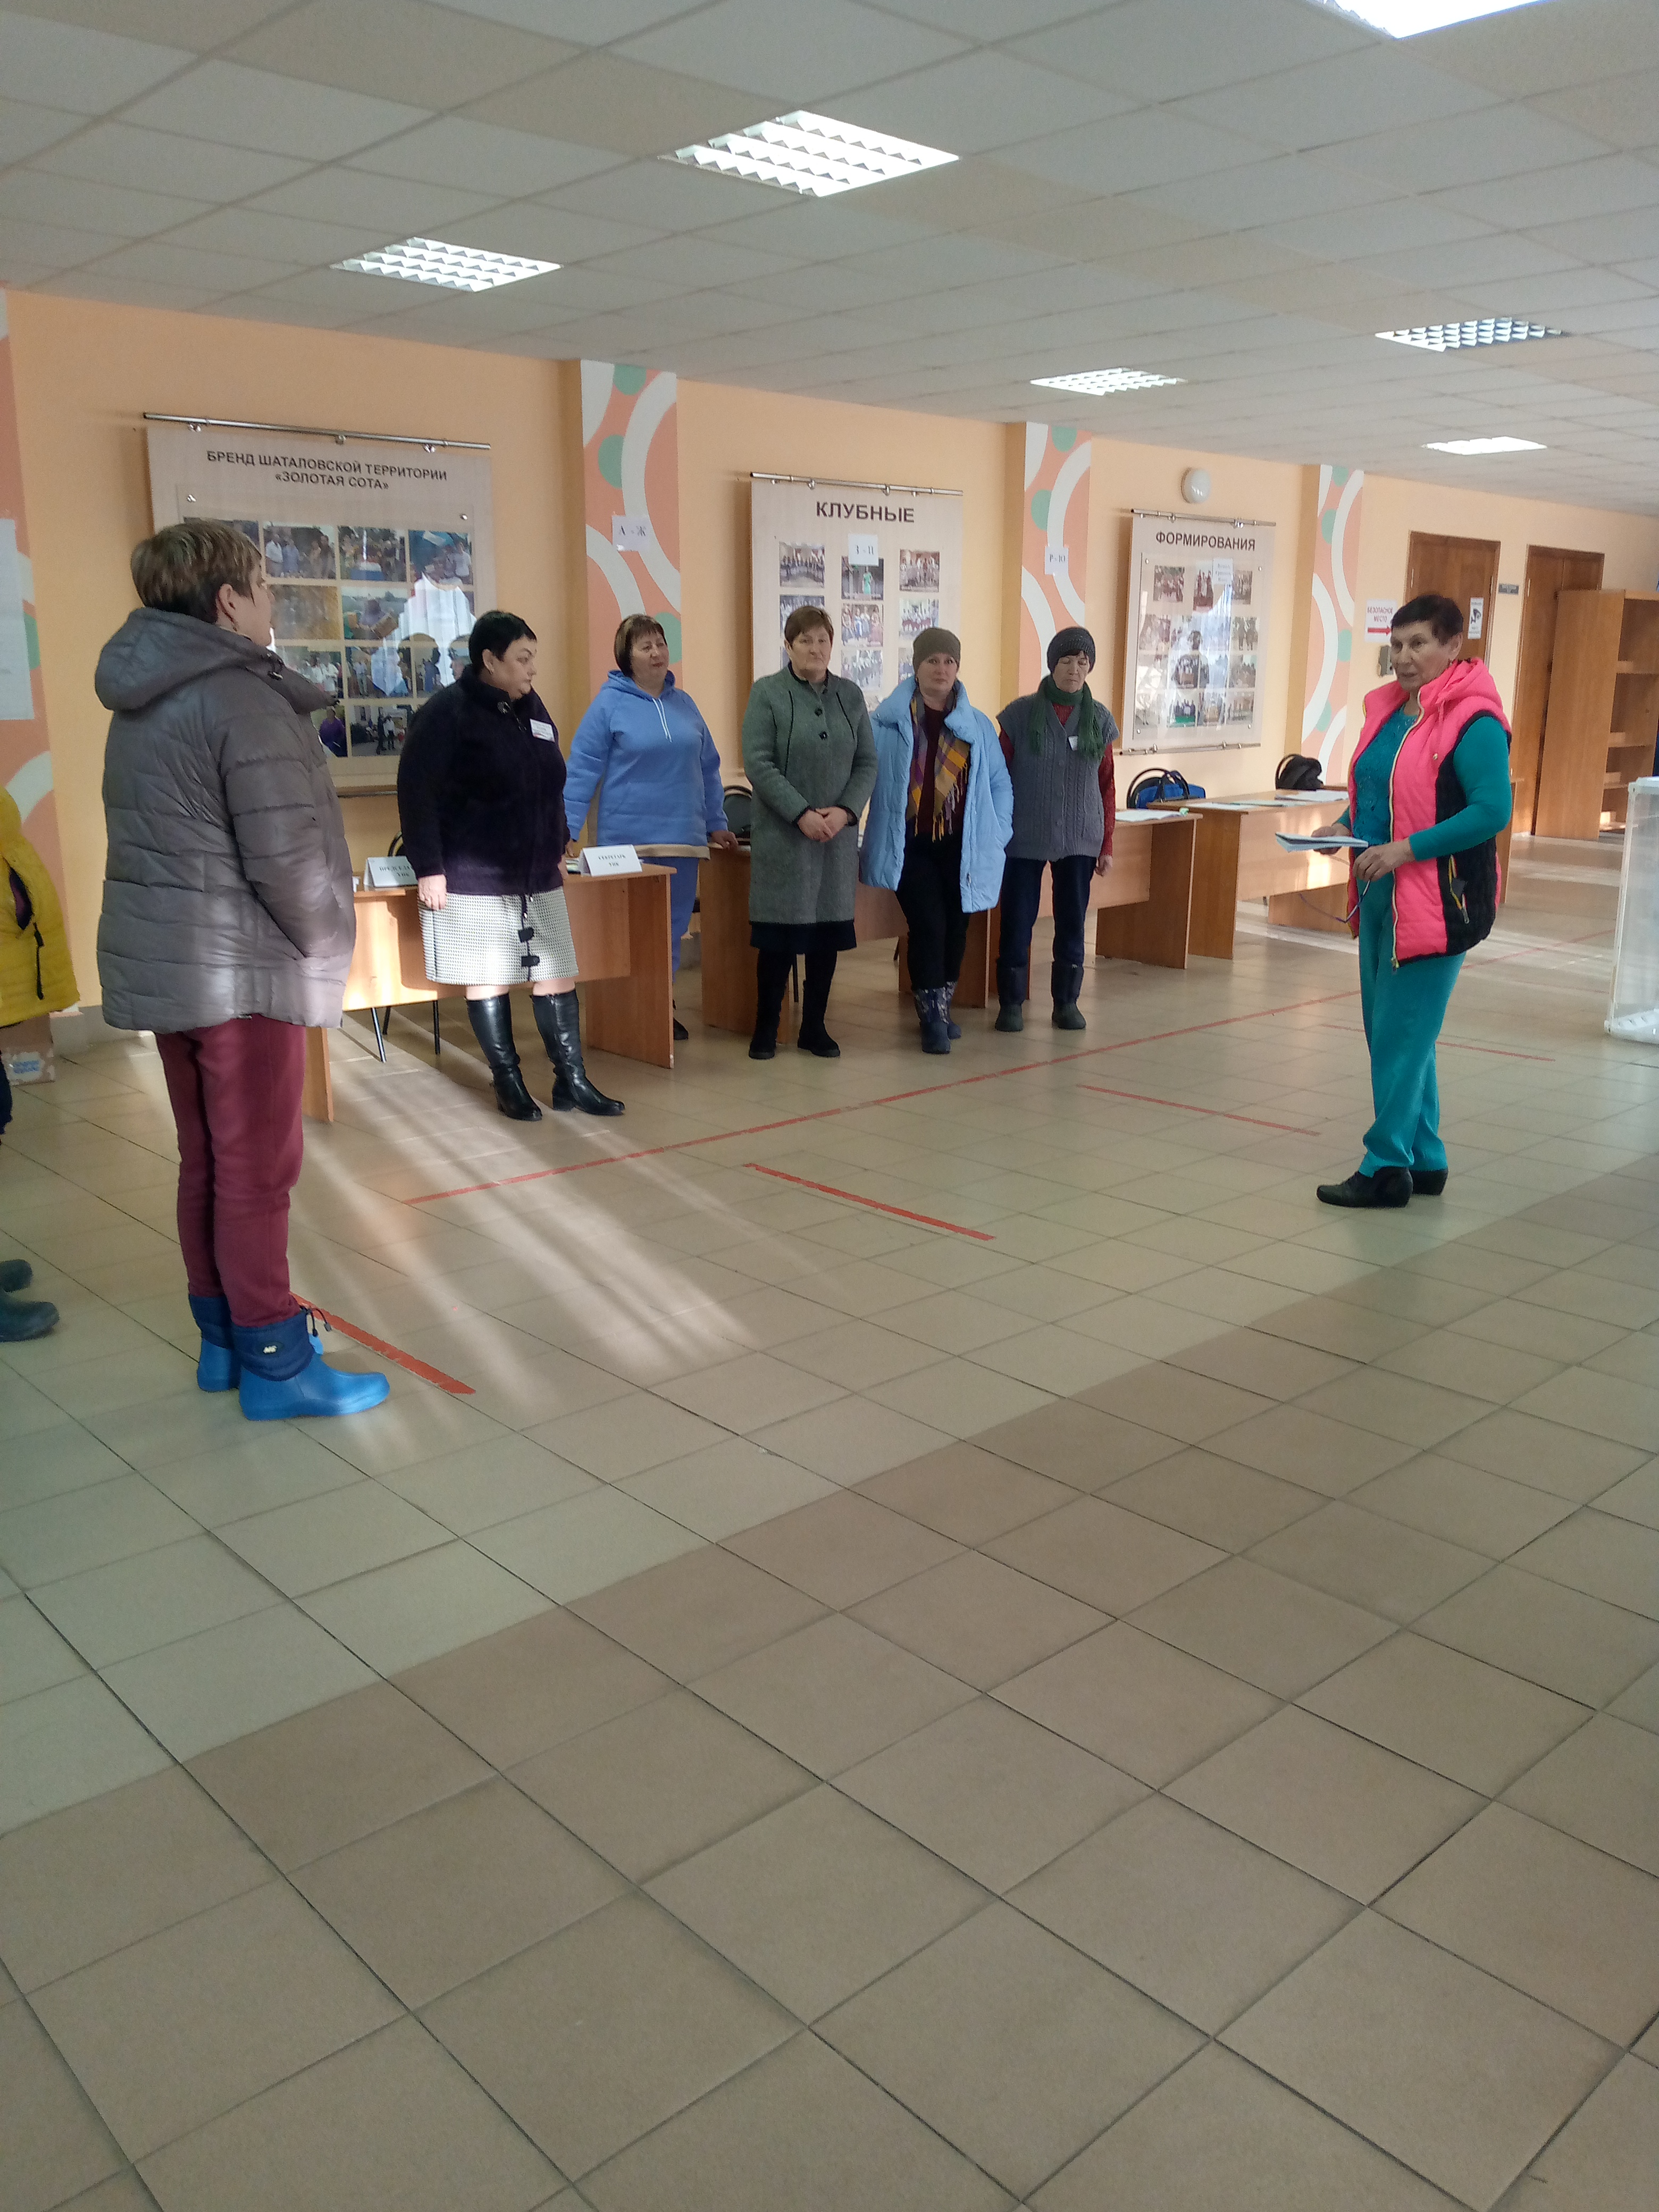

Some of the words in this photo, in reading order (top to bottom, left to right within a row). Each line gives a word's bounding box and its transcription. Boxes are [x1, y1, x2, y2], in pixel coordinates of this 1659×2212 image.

[207, 450, 255, 466] БРЕНД
[258, 455, 362, 474] ШАТАЛОВСКОЙ
[365, 463, 447, 481] ТЕРРИТОРИИ
[275, 471, 345, 487] «ЗОЛОТАЯ
[348, 476, 389, 489] СОТА»
[816, 501, 915, 523] КЛУБНЫЕ
[1155, 531, 1255, 551] ФОРМИРОВАНИЯ
